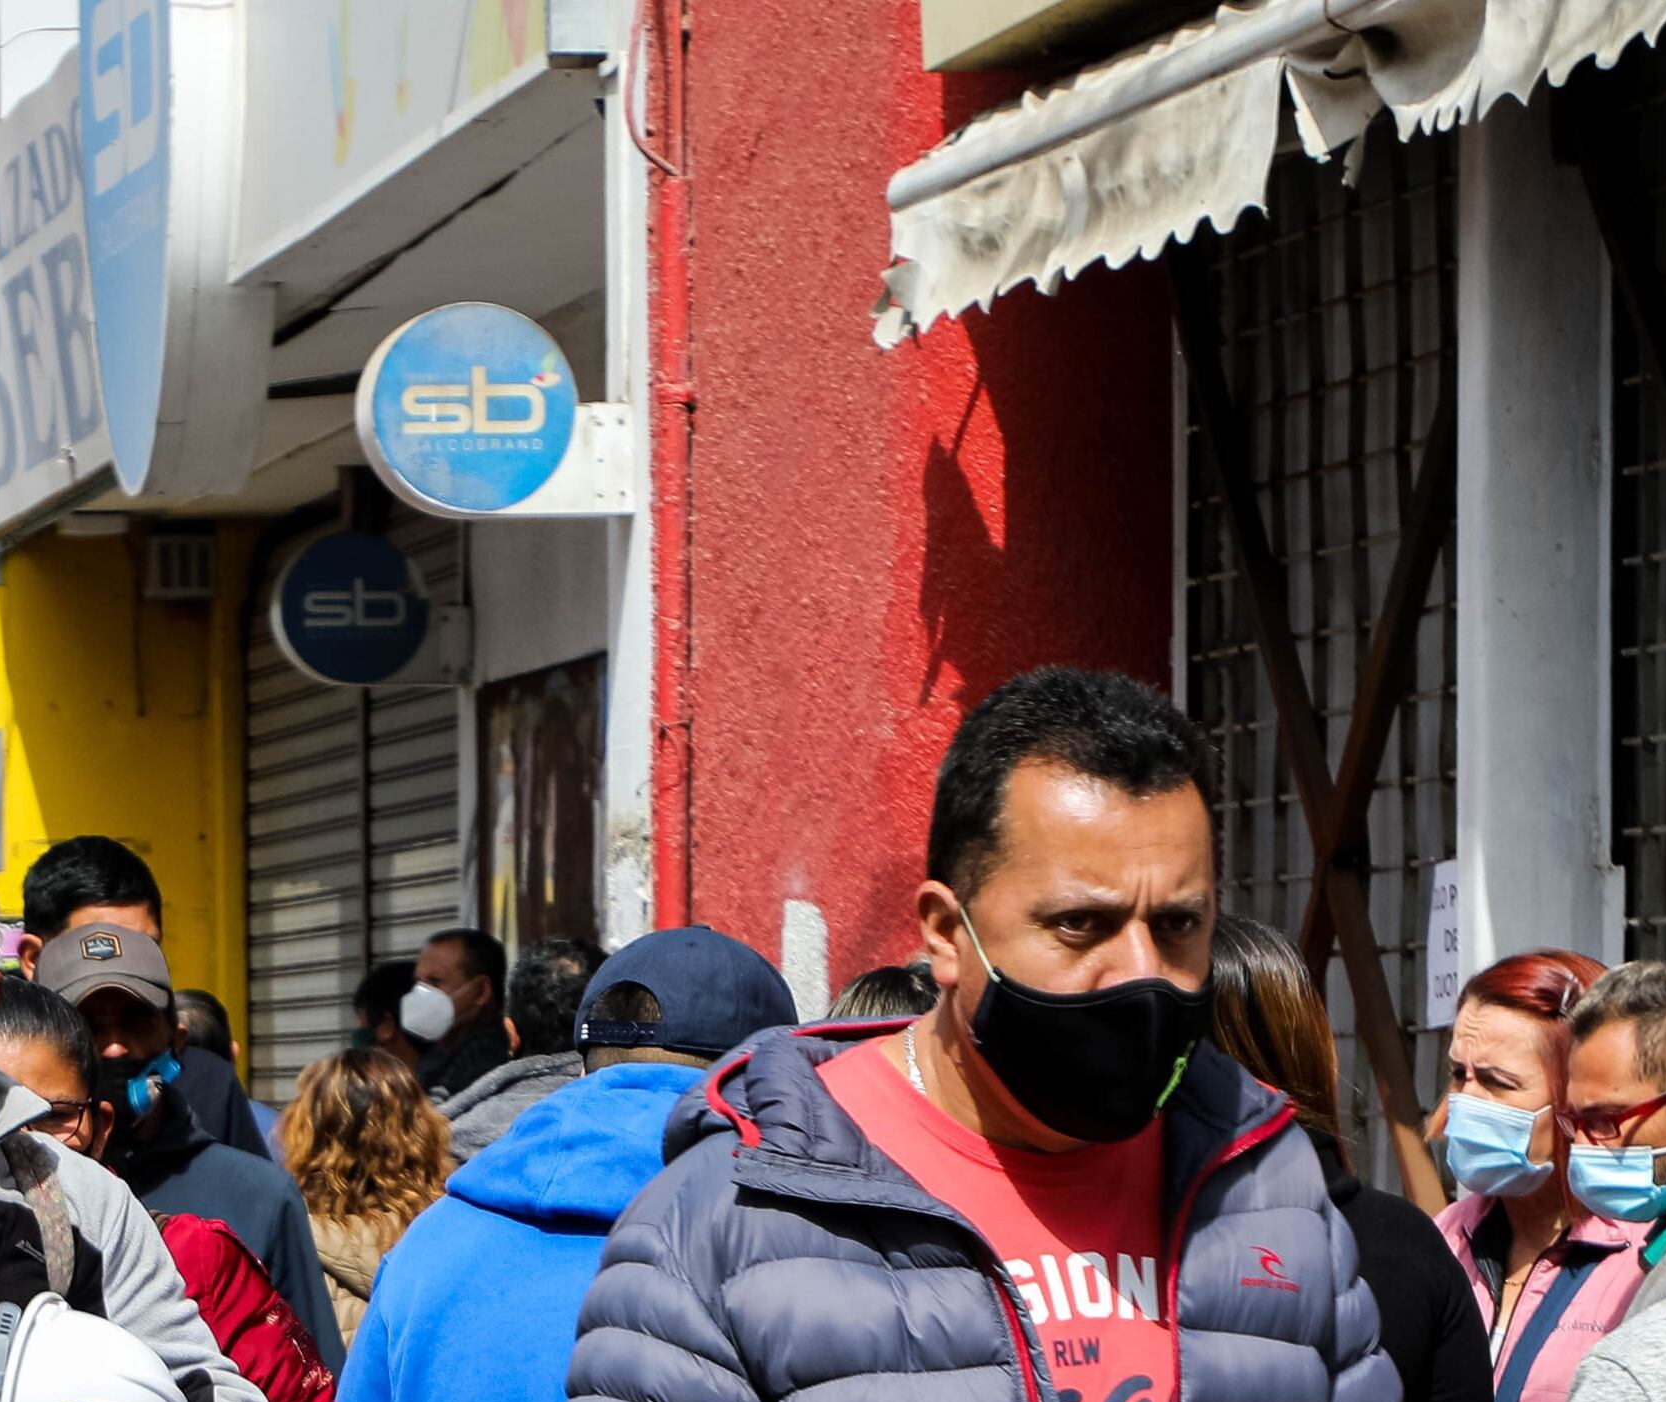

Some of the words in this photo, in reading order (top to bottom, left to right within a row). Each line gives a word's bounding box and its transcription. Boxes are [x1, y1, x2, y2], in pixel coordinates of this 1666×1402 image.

[401, 365, 547, 434] sb
[302, 576, 407, 627] sb
[1054, 1338, 1100, 1367] RLW
